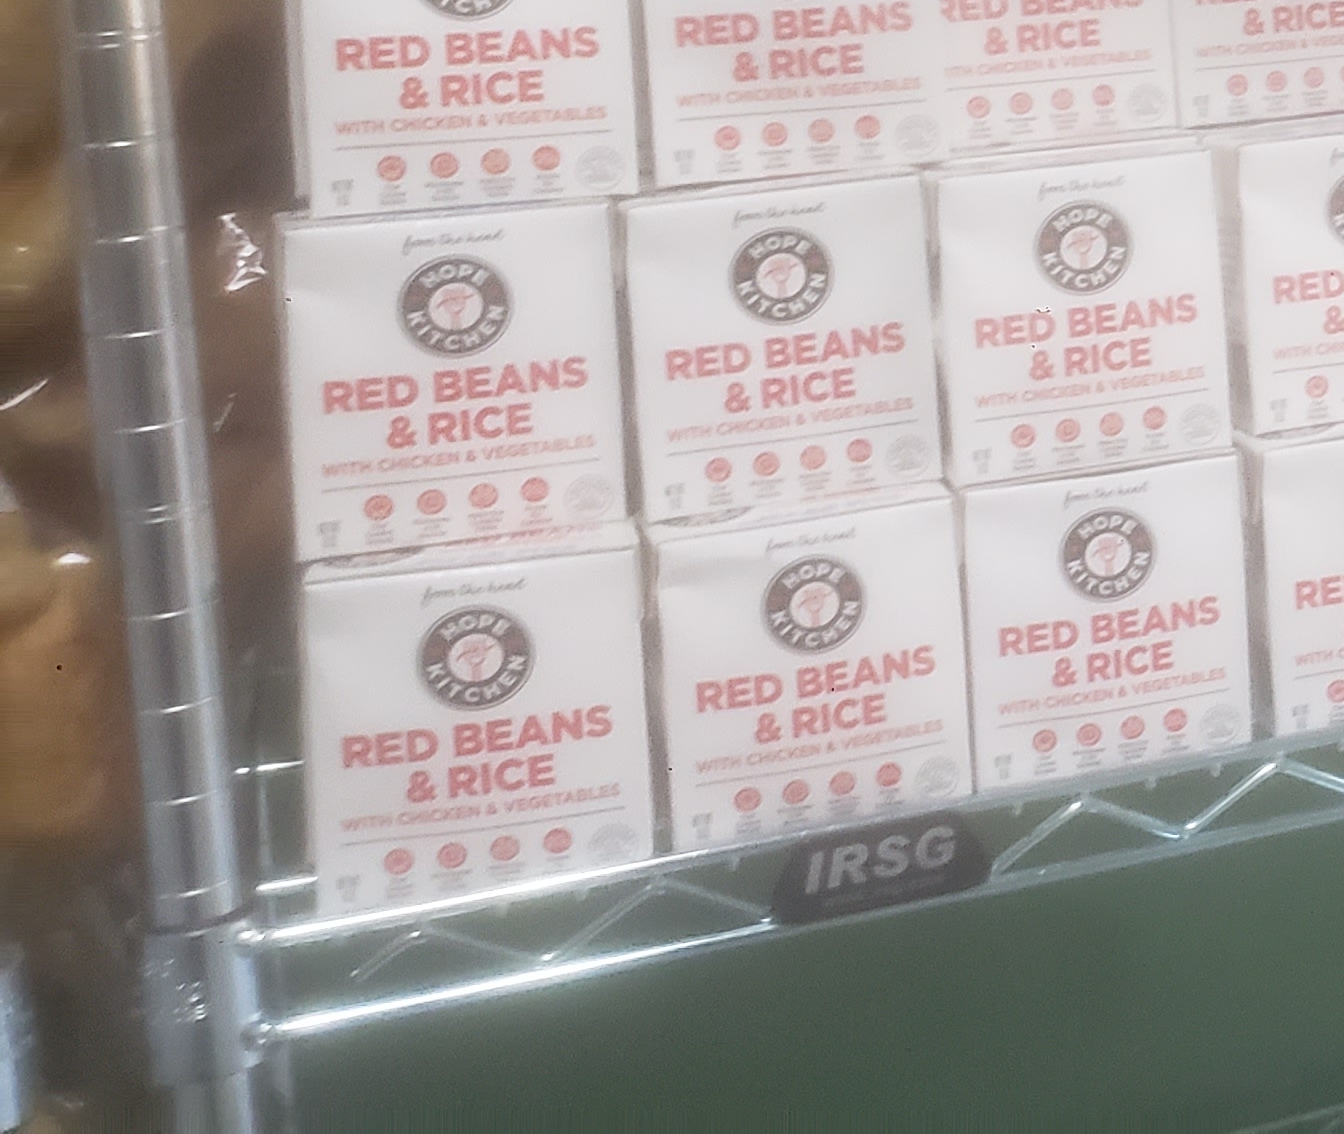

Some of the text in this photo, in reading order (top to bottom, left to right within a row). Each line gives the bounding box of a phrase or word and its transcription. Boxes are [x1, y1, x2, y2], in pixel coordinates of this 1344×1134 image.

[676, 1, 913, 48] RED BEANS
[1244, 9, 1265, 37] &
[336, 27, 599, 72] RED BEANS
[734, 44, 863, 84] & RICE
[400, 70, 543, 111] & RICE
[1052, 207, 1113, 232] HOPE
[748, 234, 813, 259] HOPE
[1039, 246, 1127, 288] KITCHEN
[423, 263, 490, 288] HOPE
[735, 272, 827, 319] KITCHEN
[406, 304, 508, 352] KITCHEN
[975, 294, 1198, 349] RED BEANS
[665, 323, 905, 382] RED BEANS
[1031, 338, 1151, 382] & RICE
[323, 357, 588, 414] RED BEANS
[725, 368, 855, 415] & RICE
[388, 404, 531, 450] & RICE
[1077, 514, 1138, 541] HOPE
[781, 563, 846, 590] HOPE
[1066, 551, 1153, 596] KITCHEN
[439, 612, 509, 640] HOPE
[770, 600, 862, 647] KITCHEN
[999, 597, 1221, 658] RED BEANS
[425, 654, 527, 703] KITCHEN
[696, 646, 936, 714] RED BEANS
[1052, 642, 1173, 690] & RICE
[342, 706, 613, 770] RED BEANS
[756, 694, 886, 745] & RICE
[407, 755, 554, 805] & RICE
[804, 825, 955, 895] IRSG
